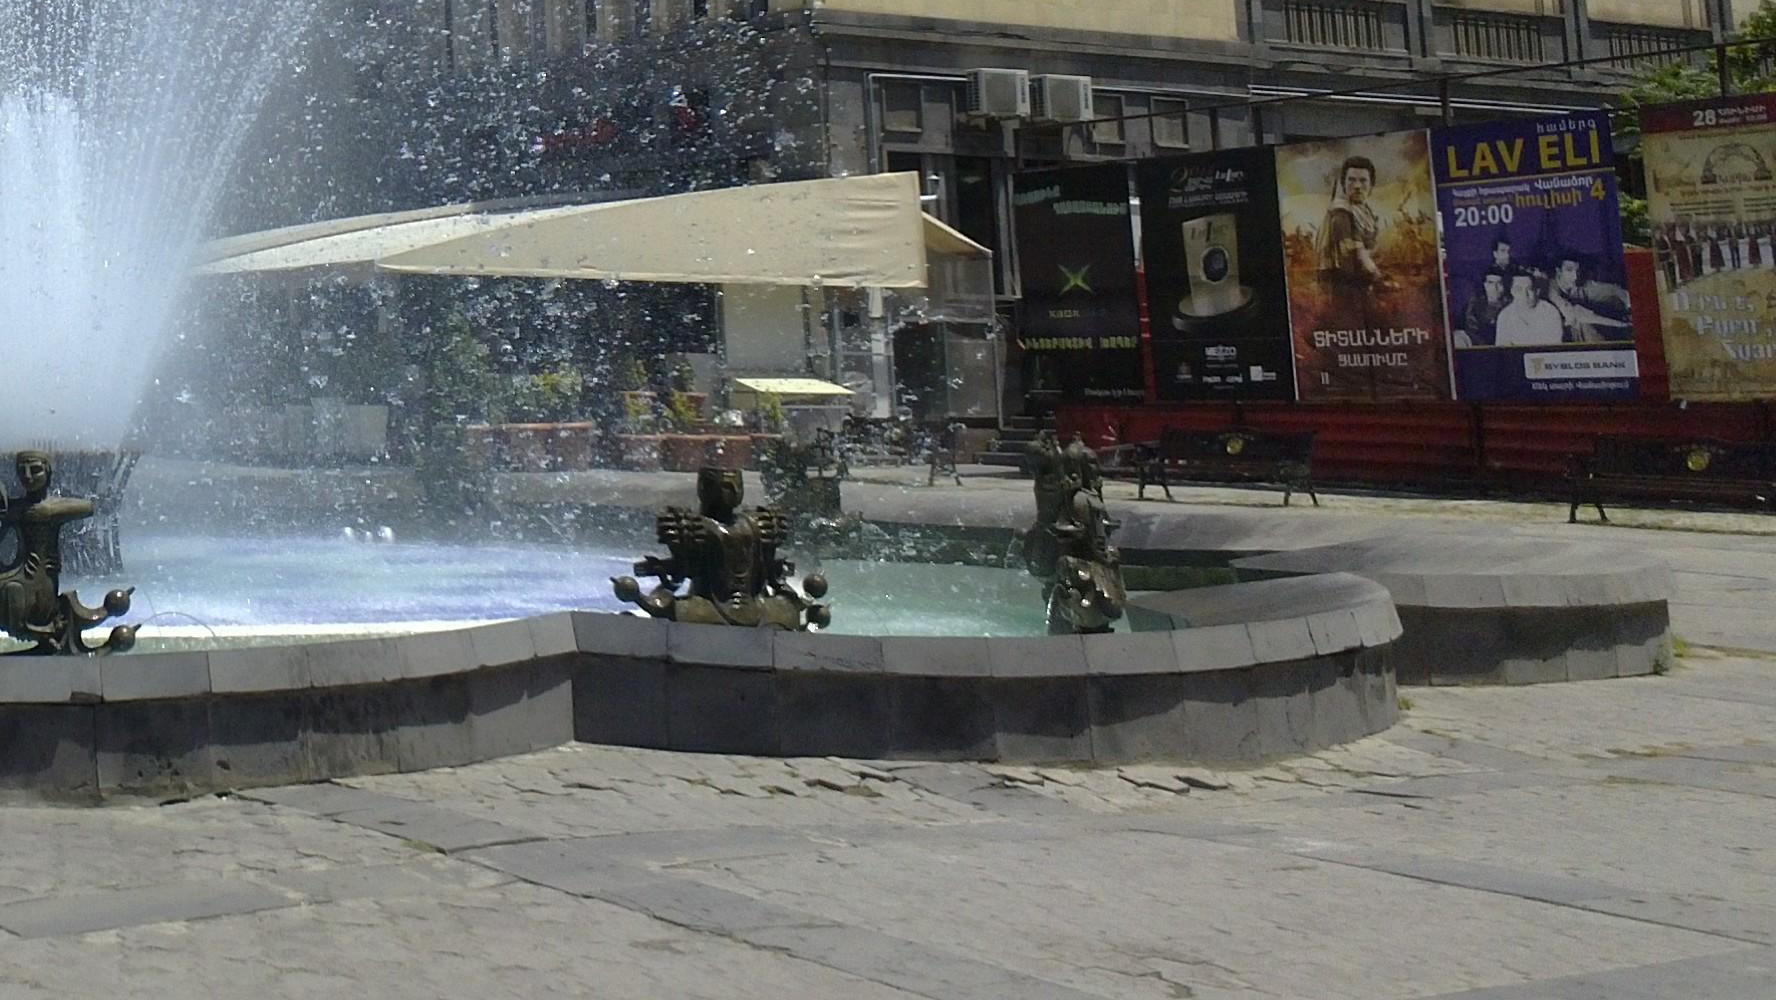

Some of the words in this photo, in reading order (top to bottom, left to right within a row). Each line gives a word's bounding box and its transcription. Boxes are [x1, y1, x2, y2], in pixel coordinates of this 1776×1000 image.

[1692, 109, 1716, 127] 28
[1447, 137, 1524, 179] LAV
[1538, 129, 1600, 169] ELI
[1590, 178, 1606, 201] 4
[1454, 204, 1513, 227] 20:00
[1313, 327, 1430, 348] ՏԻՏԱՆՆԵՐԻ
[1593, 361, 1626, 369] BANK
